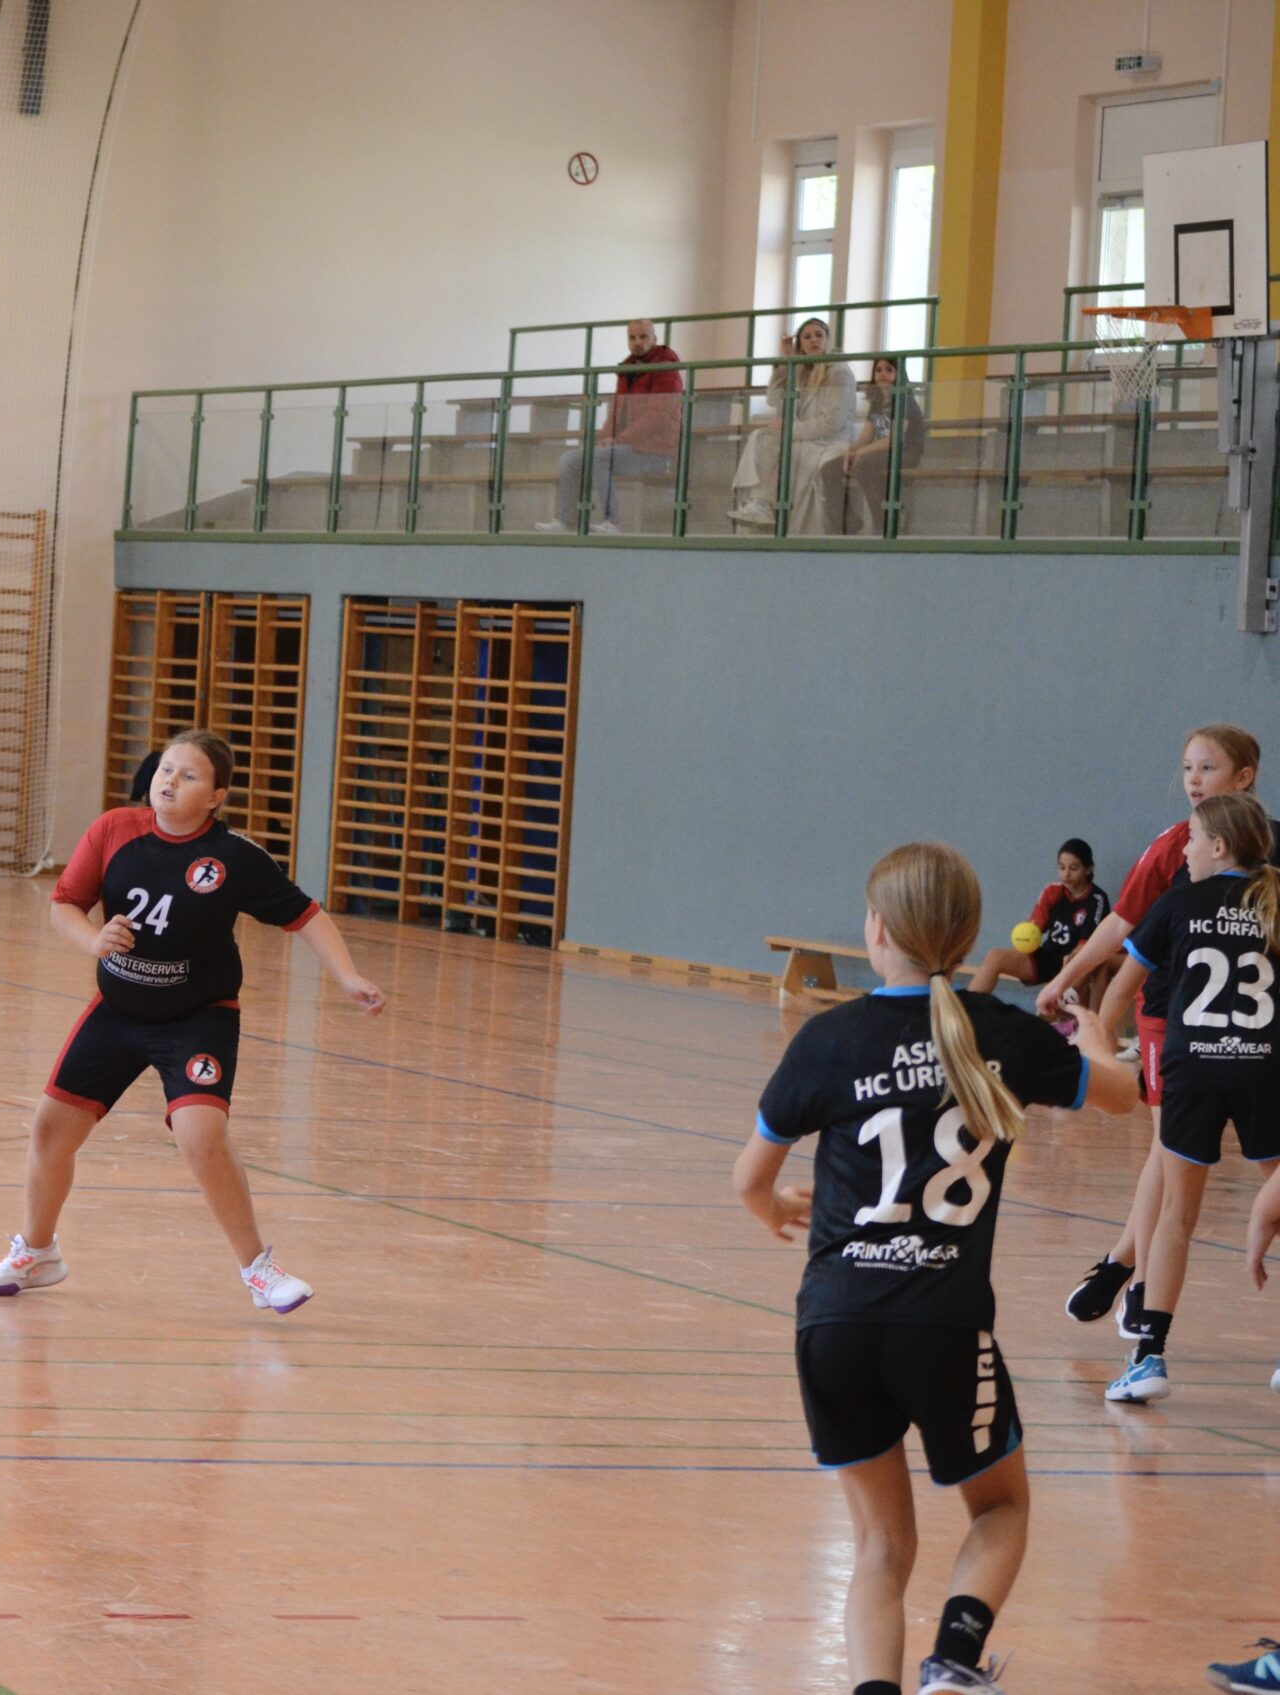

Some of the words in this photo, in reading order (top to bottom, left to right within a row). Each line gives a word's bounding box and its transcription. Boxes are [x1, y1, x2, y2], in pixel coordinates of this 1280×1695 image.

[126, 887, 174, 936] 24
[1189, 919, 1213, 934] HC
[1216, 920, 1265, 939] URFA
[1182, 947, 1275, 1029] 23
[892, 1041, 939, 1068] ASK
[854, 1073, 891, 1101] HC
[895, 1060, 1003, 1092] URFR
[853, 1105, 996, 1227] 18
